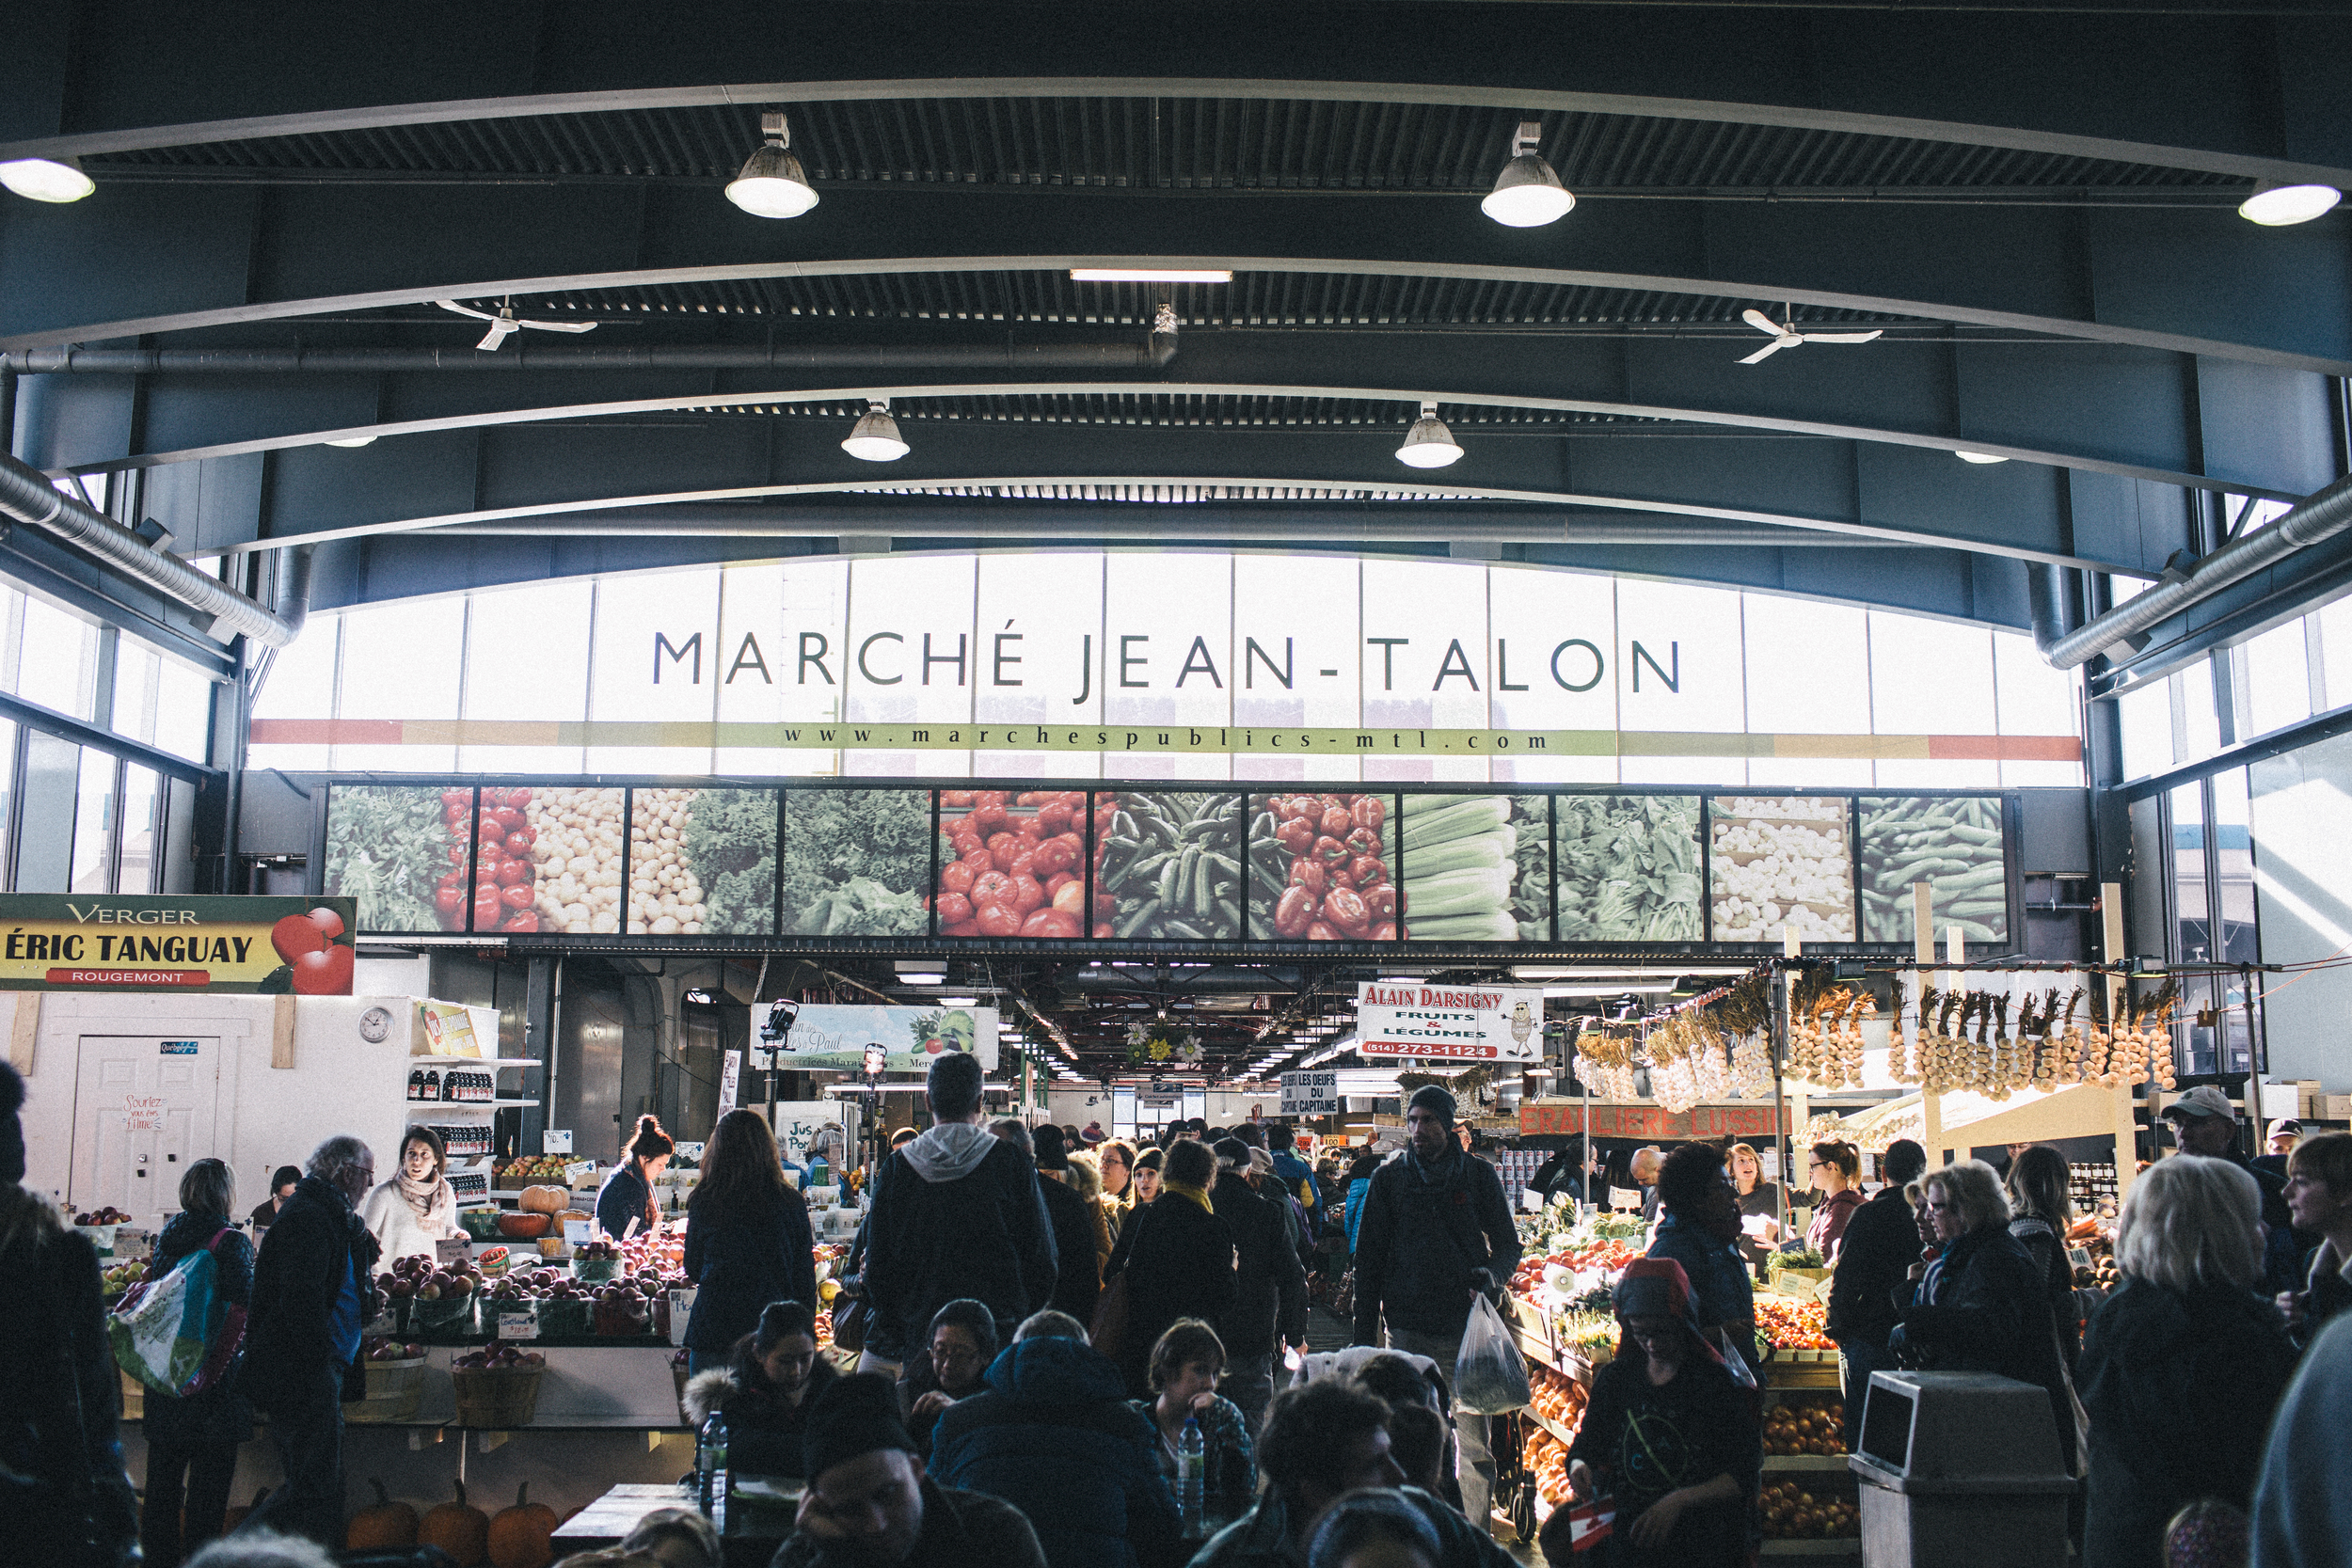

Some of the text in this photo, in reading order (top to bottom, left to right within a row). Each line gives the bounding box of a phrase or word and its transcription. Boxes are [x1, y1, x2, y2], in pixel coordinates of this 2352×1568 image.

[654, 619, 1680, 706] MARCHÉ JEAN-TALON
[784, 726, 1546, 752] www.marchespublics-mtl.com
[65, 903, 200, 925] VERGER
[5, 927, 253, 963] ÉRIC TANGUAY
[72, 972, 184, 983] ROUGEMONT
[1364, 985, 1503, 1011] ALAIN DARSIGNY
[1395, 1011, 1475, 1022] FRUITS
[1383, 1027, 1486, 1038] LÉGUMES
[809, 1032, 843, 1054] Paul
[1367, 1043, 1488, 1056] (514) 273-1124
[1298, 1073, 1336, 1086] LES OEUFS
[1311, 1087, 1324, 1098] DU
[123, 1094, 163, 1112] Souriez
[1299, 1100, 1336, 1113] CAPITAINE
[1520, 1107, 1679, 1135] ERABLIERE
